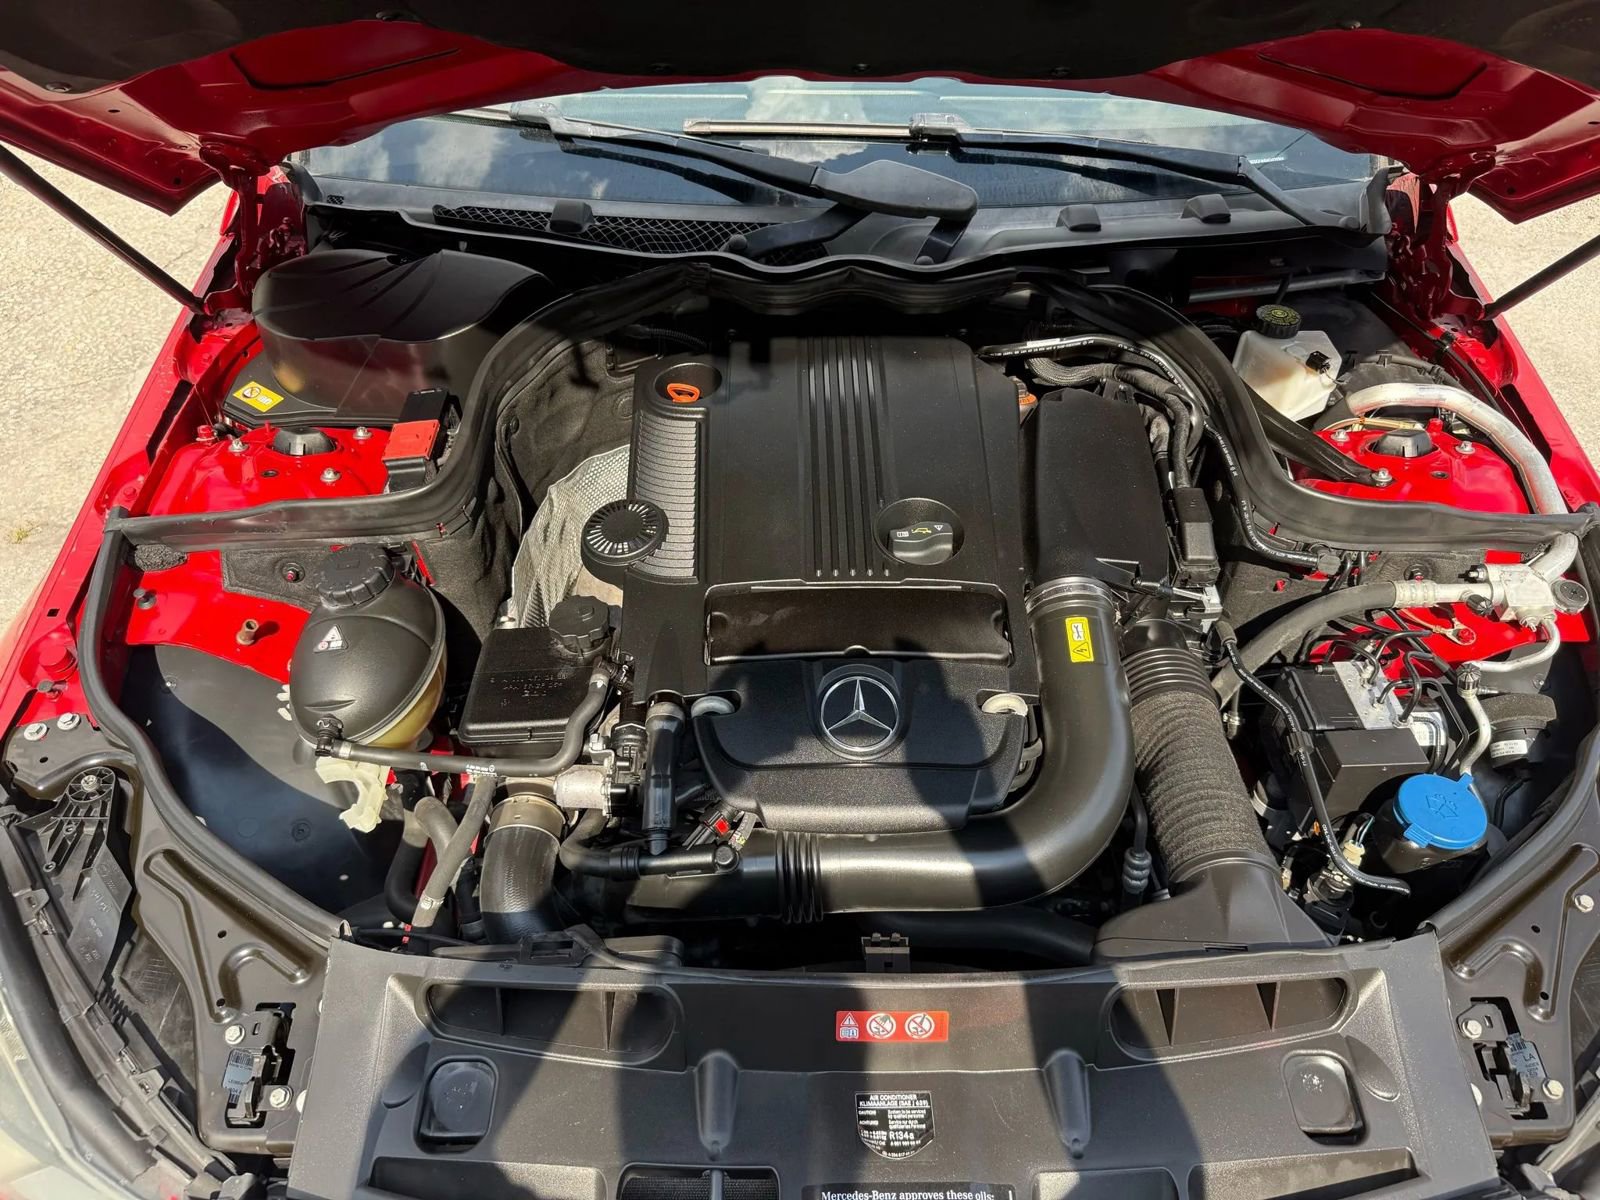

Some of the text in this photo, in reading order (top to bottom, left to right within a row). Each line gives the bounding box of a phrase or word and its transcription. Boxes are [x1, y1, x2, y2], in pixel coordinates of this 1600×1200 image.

[821, 1190, 897, 1200] Mercedes-Benz
[899, 1191, 945, 1200] approves
[946, 1190, 973, 1200] these
